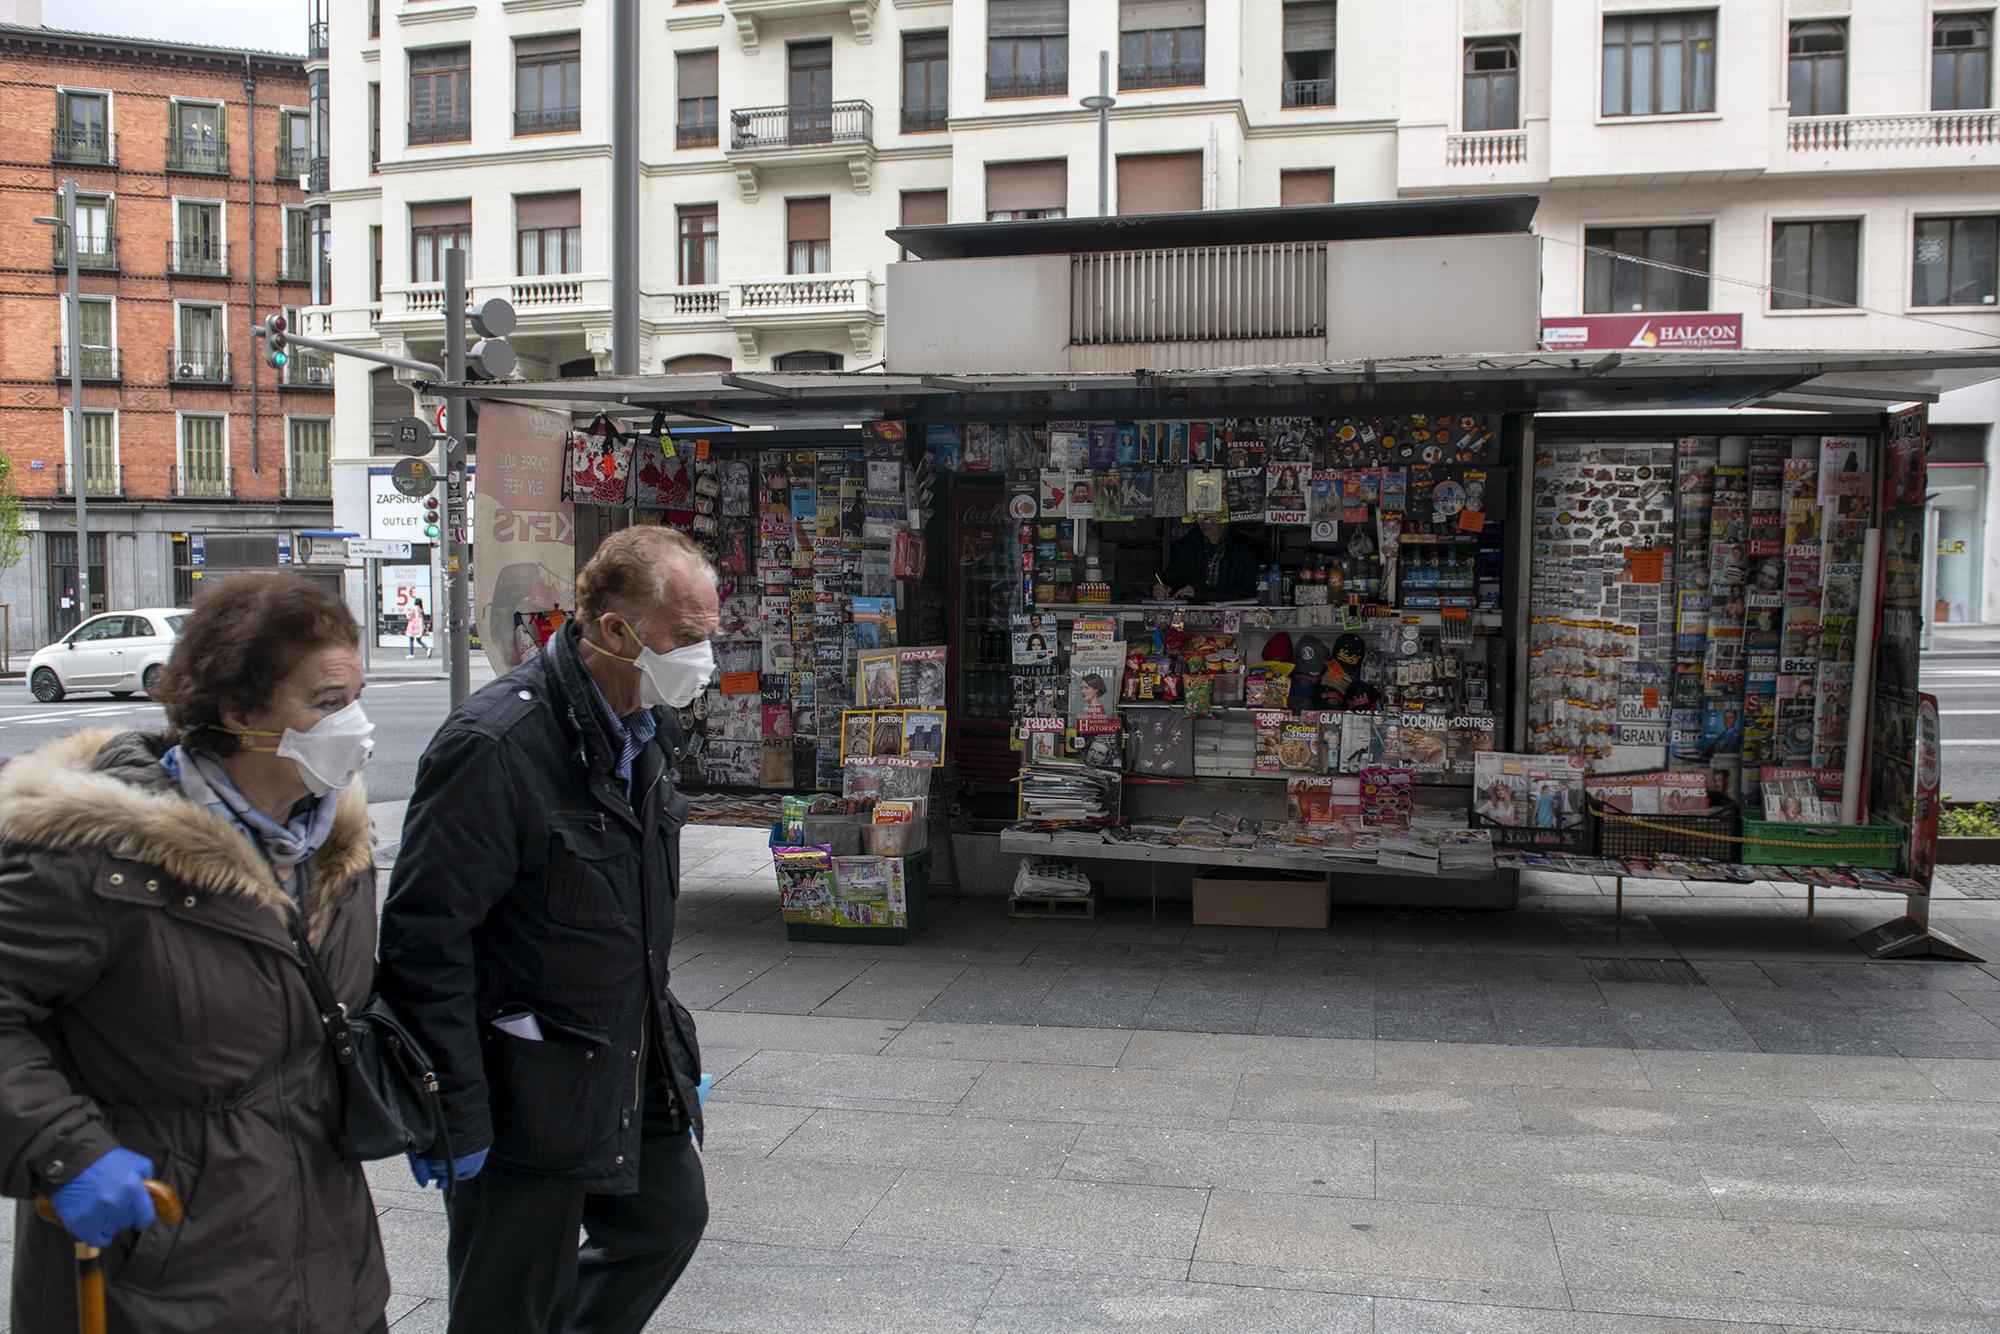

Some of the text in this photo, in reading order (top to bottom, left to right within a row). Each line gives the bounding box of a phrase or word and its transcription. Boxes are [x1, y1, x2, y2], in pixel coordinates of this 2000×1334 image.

[1660, 325, 1736, 340] HALCON
[382, 517, 419, 526] OUTLET
[1270, 512, 1306, 522] UNCUT
[1706, 670, 1743, 684] bikes
[1256, 712, 1285, 721] SABER
[1401, 713, 1448, 728] COCINA
[1449, 715, 1494, 729] POSTRES
[1623, 729, 1654, 742] GRAN
[1820, 772, 1846, 783] MOD
